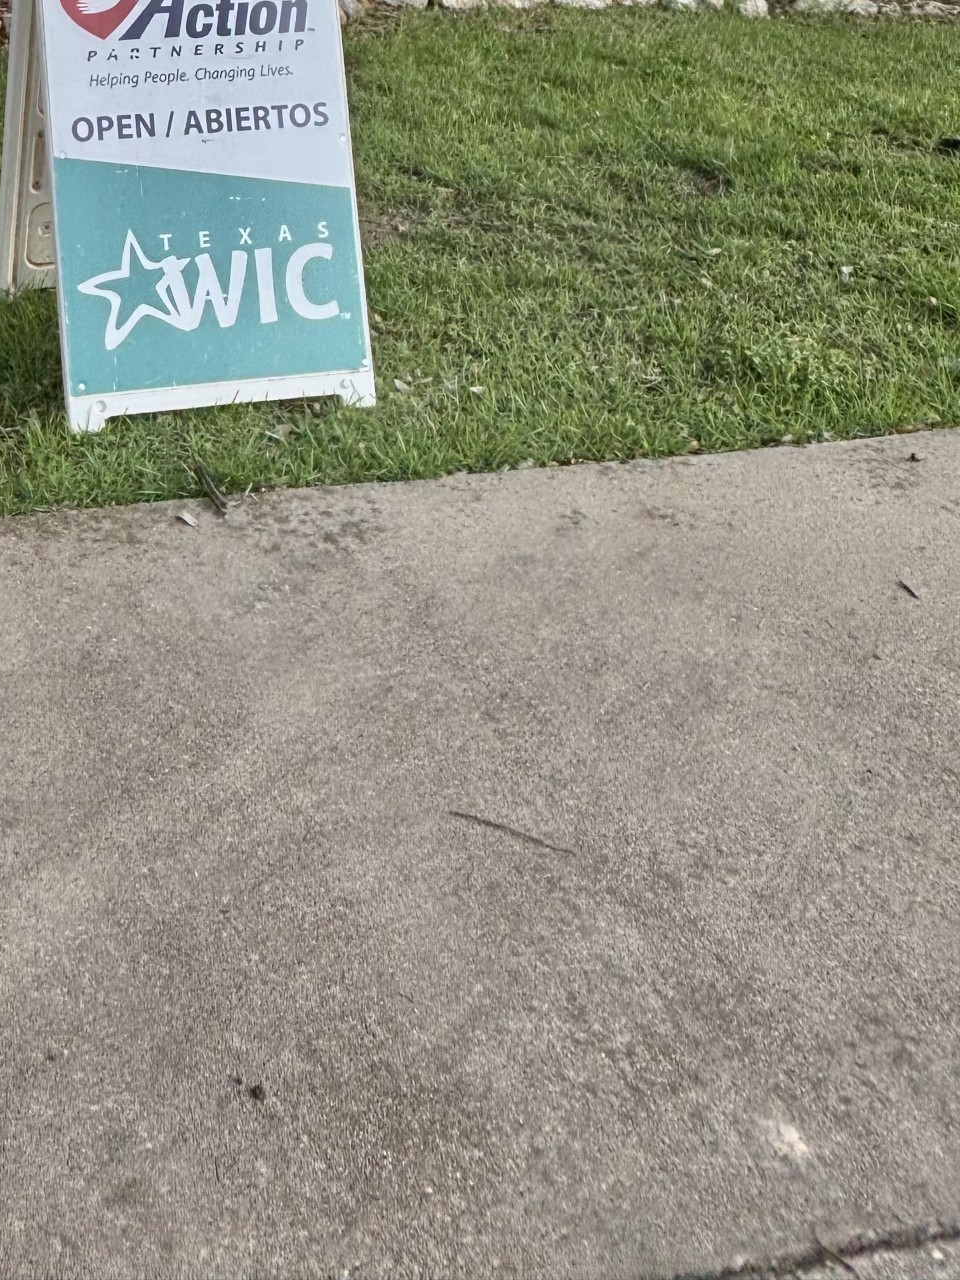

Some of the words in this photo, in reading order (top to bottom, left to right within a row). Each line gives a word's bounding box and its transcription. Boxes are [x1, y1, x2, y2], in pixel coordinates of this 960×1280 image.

[87, 39, 305, 62] PARTNERSHIP
[89, 68, 139, 88] Helping
[144, 68, 190, 84] People.
[194, 65, 256, 83] Changing
[260, 64, 294, 77] Lives.
[71, 112, 156, 143] OPEN
[165, 110, 175, 138] /
[183, 102, 330, 136] ABIERTOS
[159, 221, 329, 251] TEXAS
[160, 242, 340, 332] WIC
